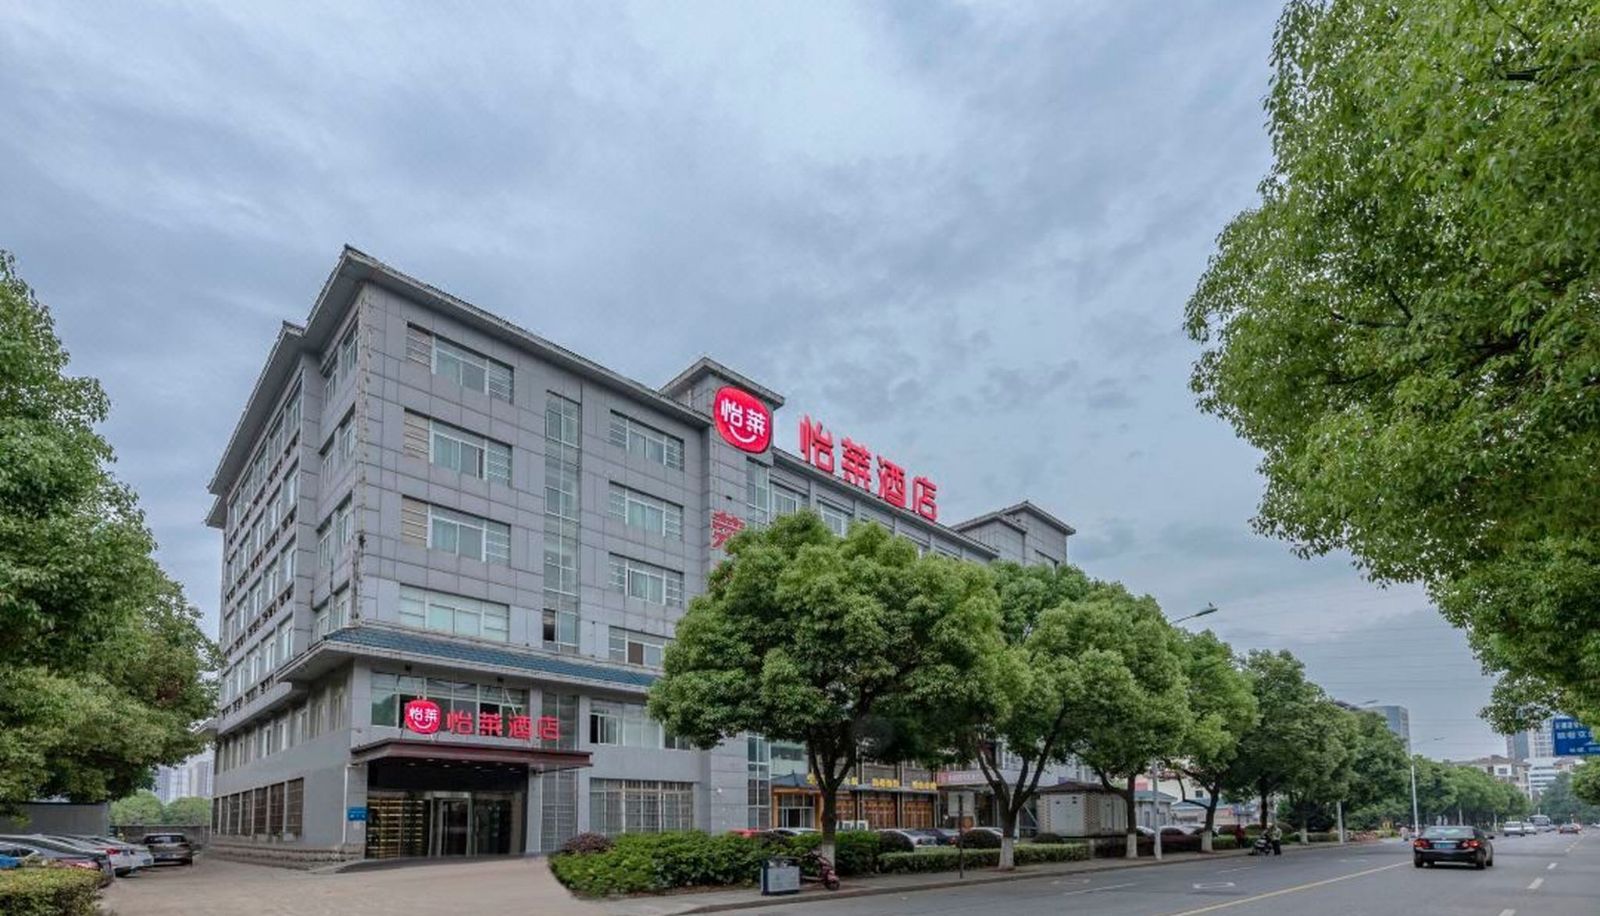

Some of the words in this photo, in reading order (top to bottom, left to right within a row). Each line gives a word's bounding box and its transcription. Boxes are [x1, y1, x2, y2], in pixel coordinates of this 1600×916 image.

[720, 398, 766, 437] 怡莱
[799, 415, 938, 523] 怡莱酒店
[409, 706, 438, 723] 怡莱
[446, 710, 560, 740] 怡莱酒店
